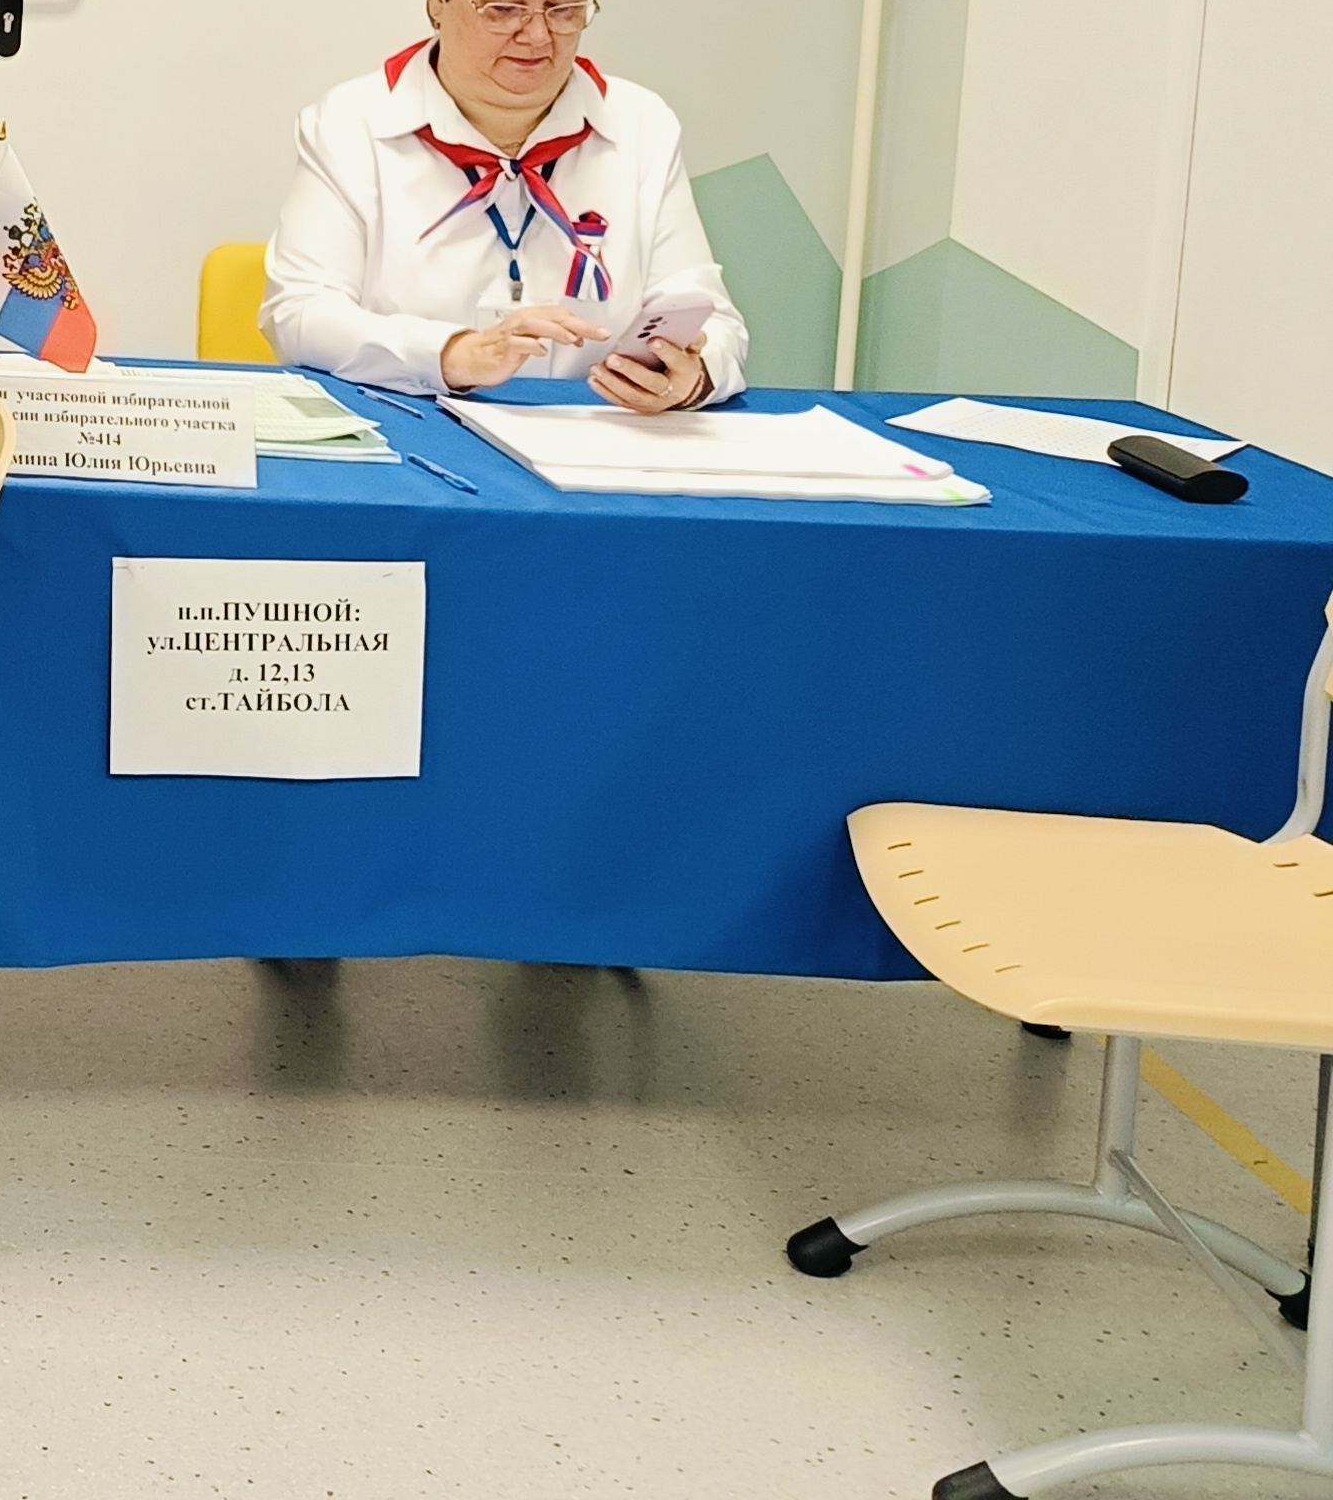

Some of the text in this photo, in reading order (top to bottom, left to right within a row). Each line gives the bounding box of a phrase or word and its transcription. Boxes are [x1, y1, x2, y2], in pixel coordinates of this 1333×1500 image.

[16, 390, 107, 406] участковой
[111, 394, 231, 411] избирательной
[44, 411, 170, 429] избирательного
[173, 418, 236, 432] участка
[76, 431, 122, 446] №414
[11, 452, 217, 476] мина Юлия Юрьевна
[177, 598, 361, 623] н.п.ПУШНОЙ:
[146, 632, 390, 655] ул.ЦЕНТРАЛЬНАЯ
[228, 663, 316, 685] д. 12,13
[185, 690, 351, 714] ст.ТАЙБОЛА
